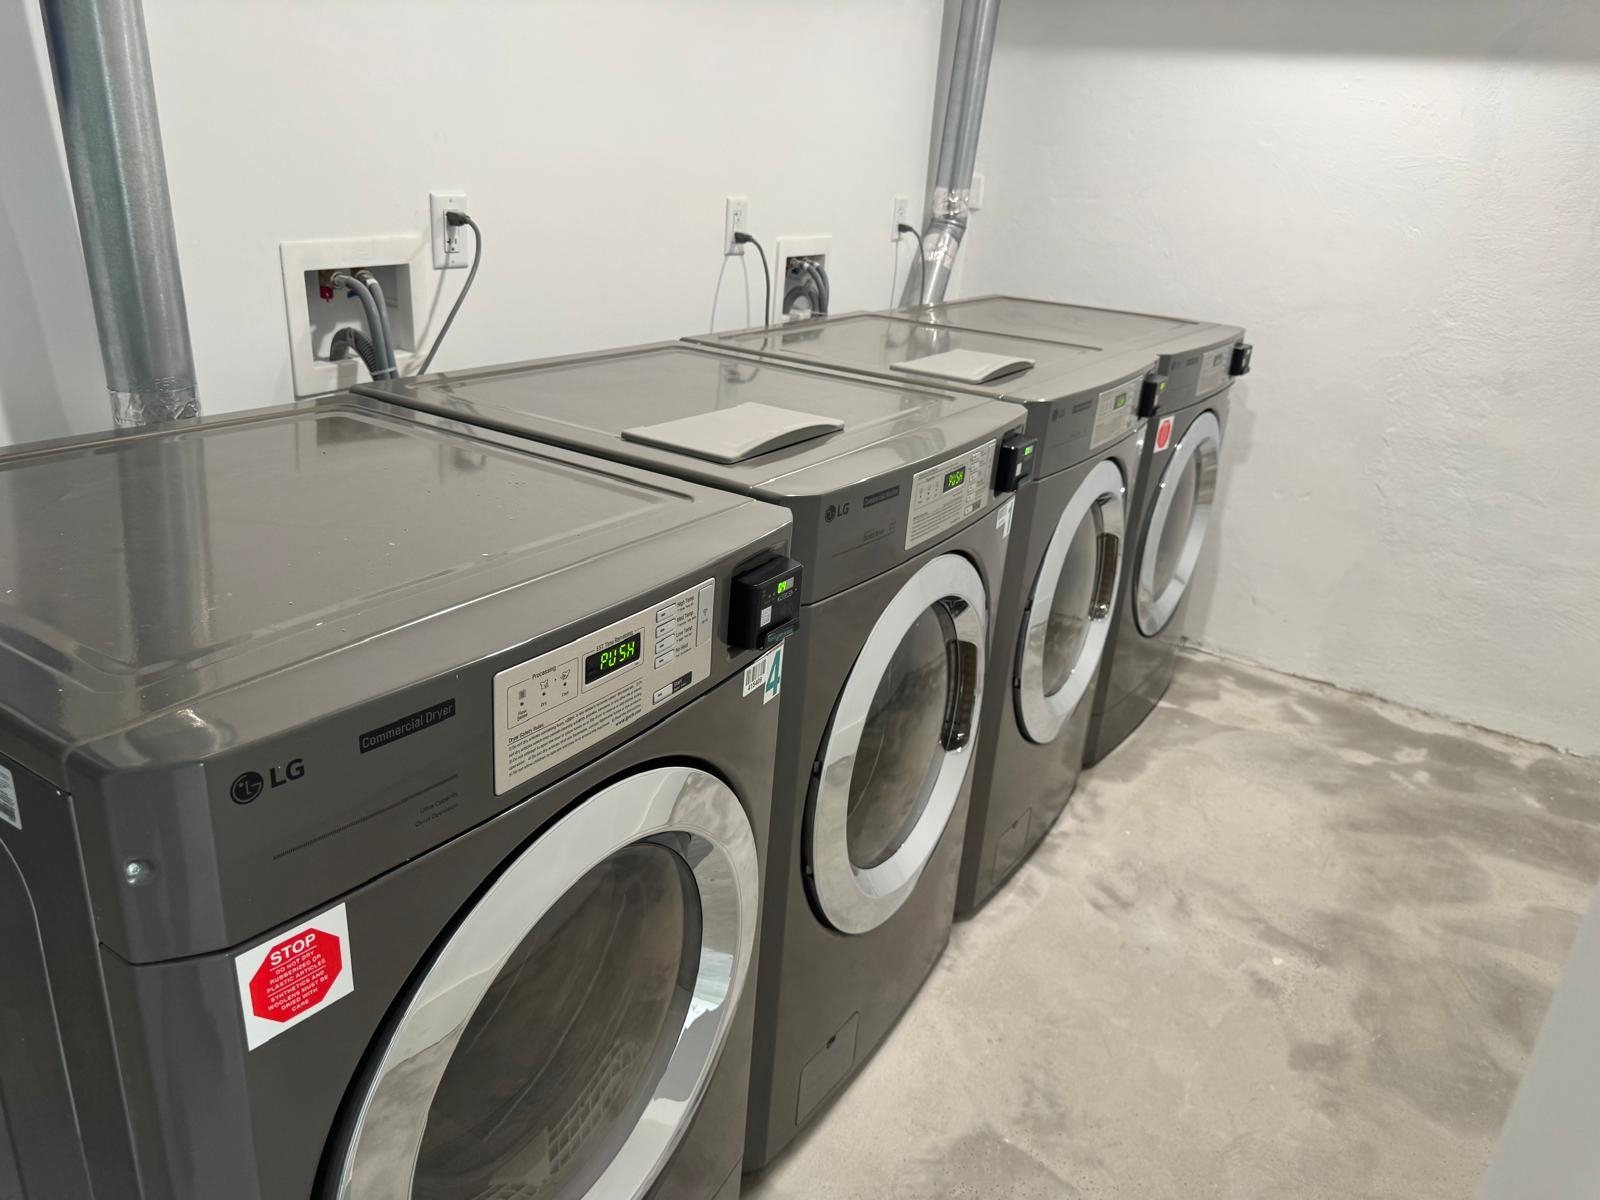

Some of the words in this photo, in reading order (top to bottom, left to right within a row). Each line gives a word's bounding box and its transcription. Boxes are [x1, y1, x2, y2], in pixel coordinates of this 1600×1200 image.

[837, 502, 849, 517] LG
[600, 641, 635, 670] PUSH
[532, 666, 557, 680] Processing
[766, 650, 781, 696] 4
[362, 715, 424, 749] Commercial
[425, 704, 453, 724] Dryer
[269, 758, 305, 788] LG
[270, 934, 316, 966] STOP
[275, 967, 286, 975] DO
[287, 958, 300, 969] NOT
[301, 951, 314, 961] DRY
[266, 976, 294, 993] PLASTIC
[296, 958, 326, 979] ARTICLES
[270, 961, 311, 985] RUBBERIZED
[312, 954, 321, 962] OR
[267, 990, 301, 1011] WOOLENS
[301, 981, 319, 992] MUST
[319, 974, 328, 983] BE
[270, 978, 310, 1003] SYNTHETICS
[311, 970, 325, 980] AND
[281, 997, 301, 1011] DRIED
[302, 988, 318, 999] WITH
[291, 999, 309, 1011] CARE
